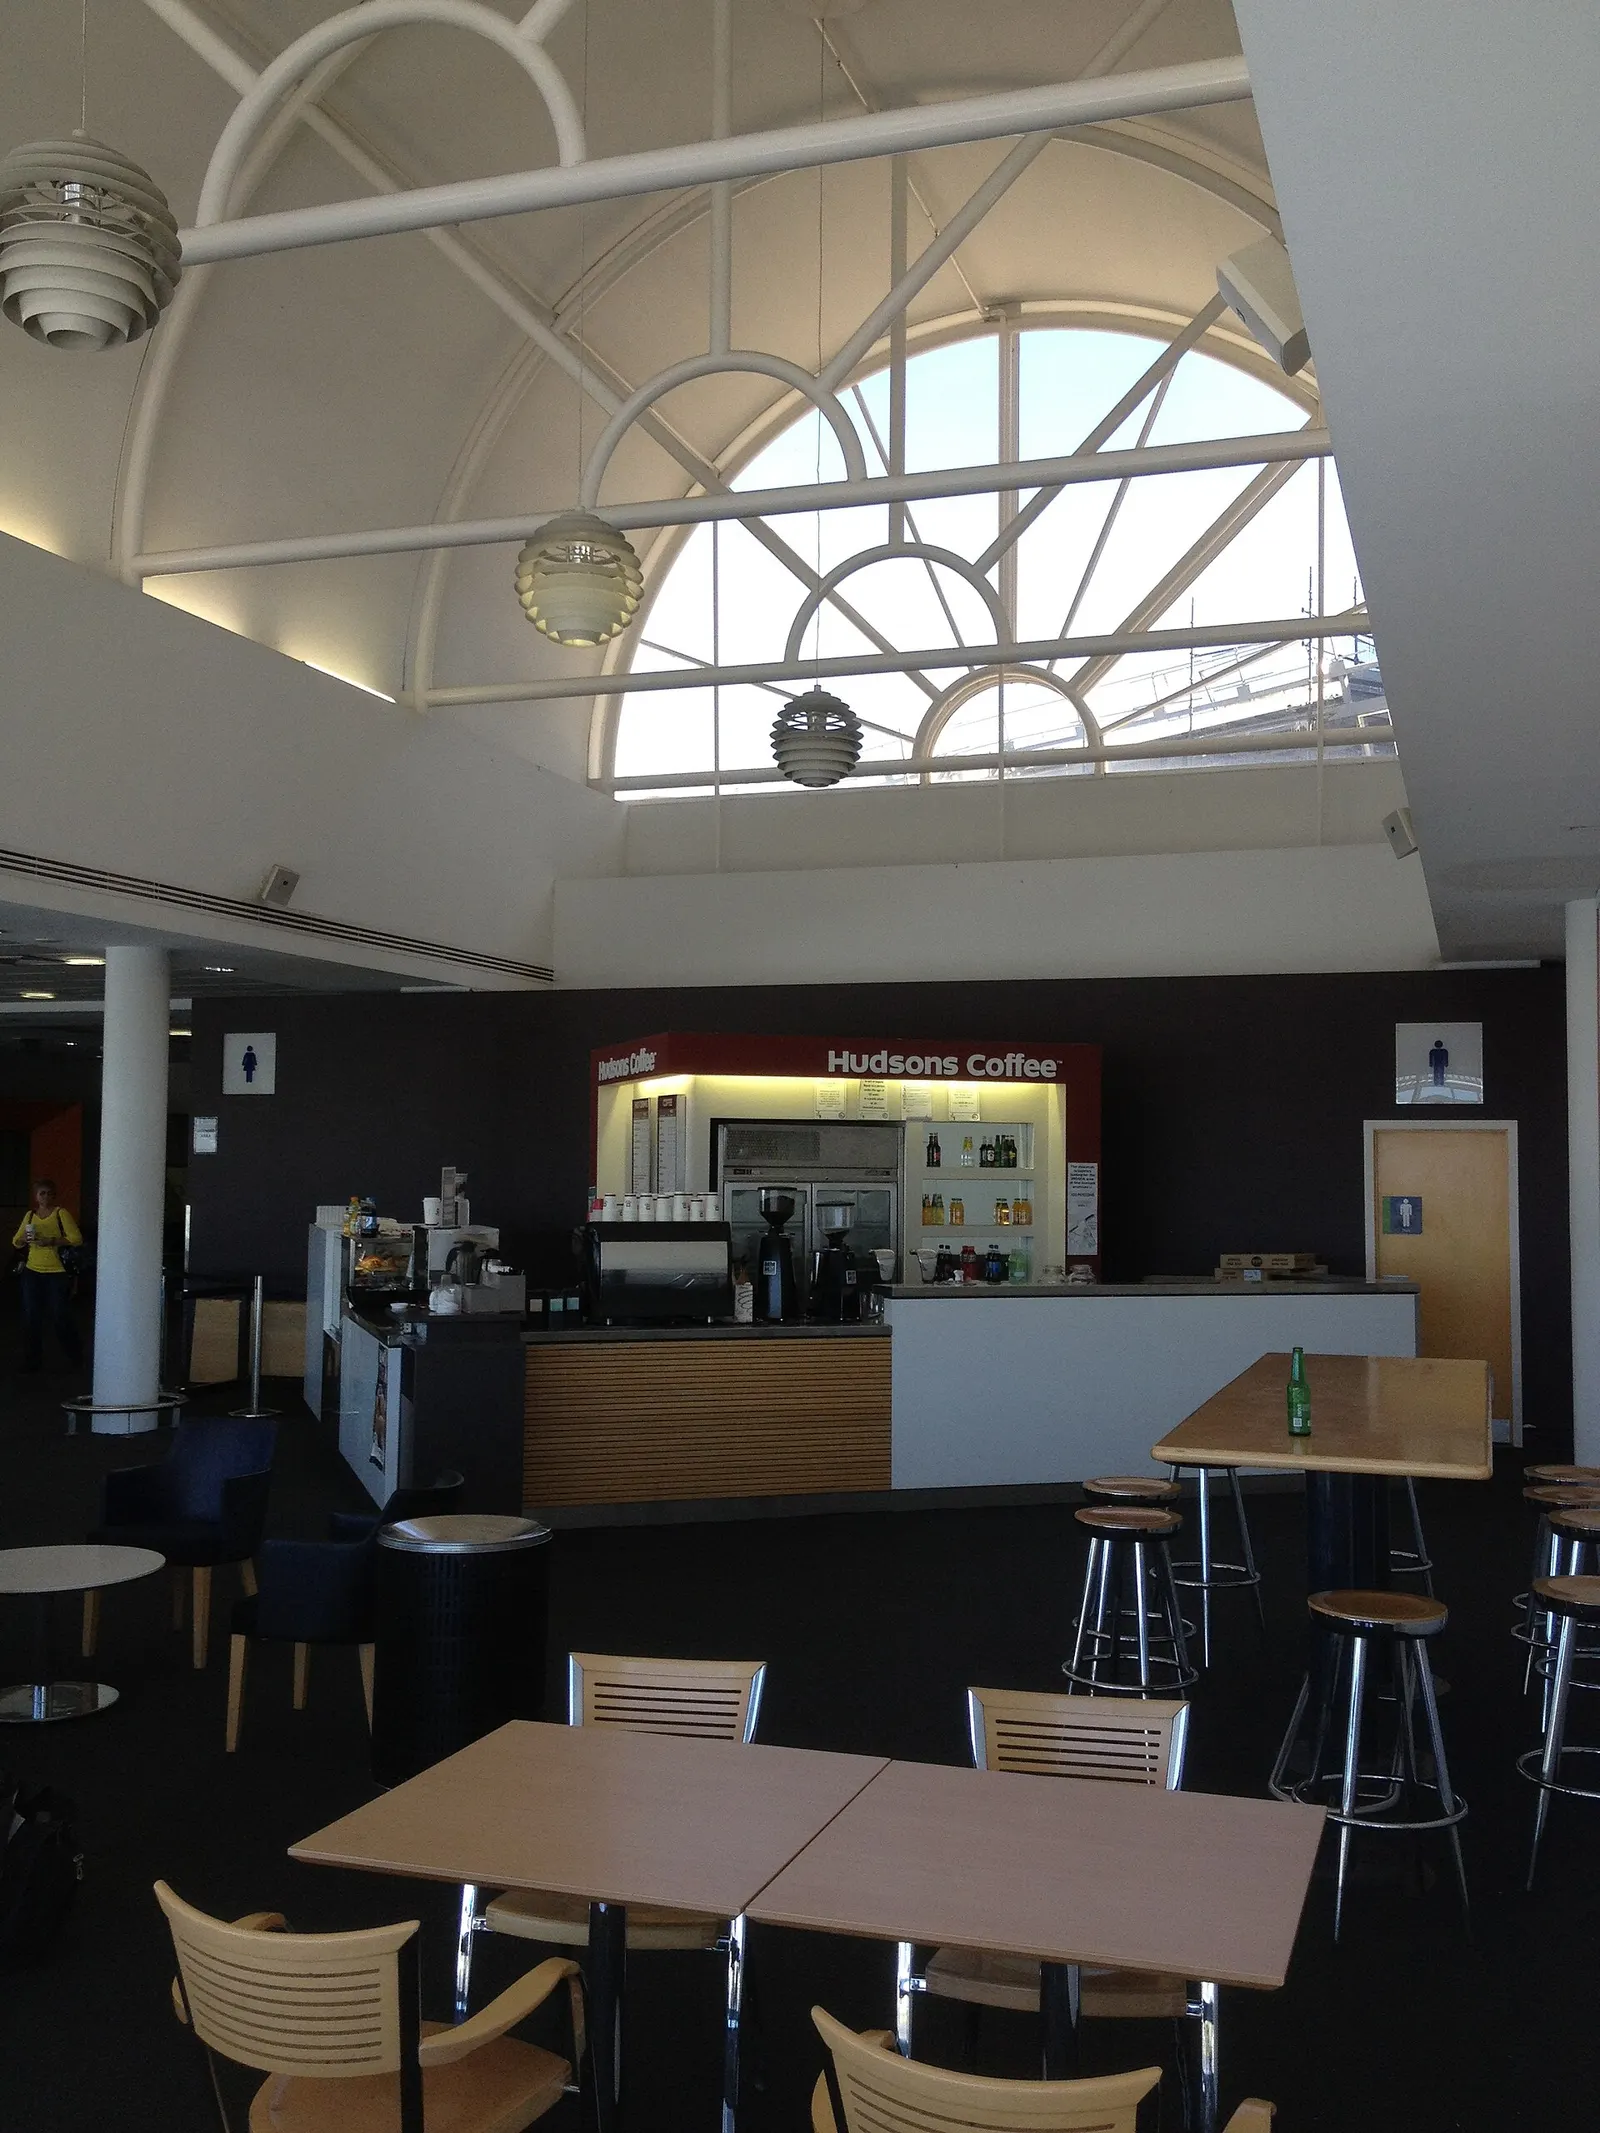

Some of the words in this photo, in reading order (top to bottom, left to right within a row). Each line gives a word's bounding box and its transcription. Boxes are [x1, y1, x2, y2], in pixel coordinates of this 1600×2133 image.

[599, 1057, 630, 1081] Hudsons
[630, 1047, 655, 1075] Coffee
[828, 1050, 959, 1076] Hudsons
[966, 1053, 1057, 1078] Coffee
